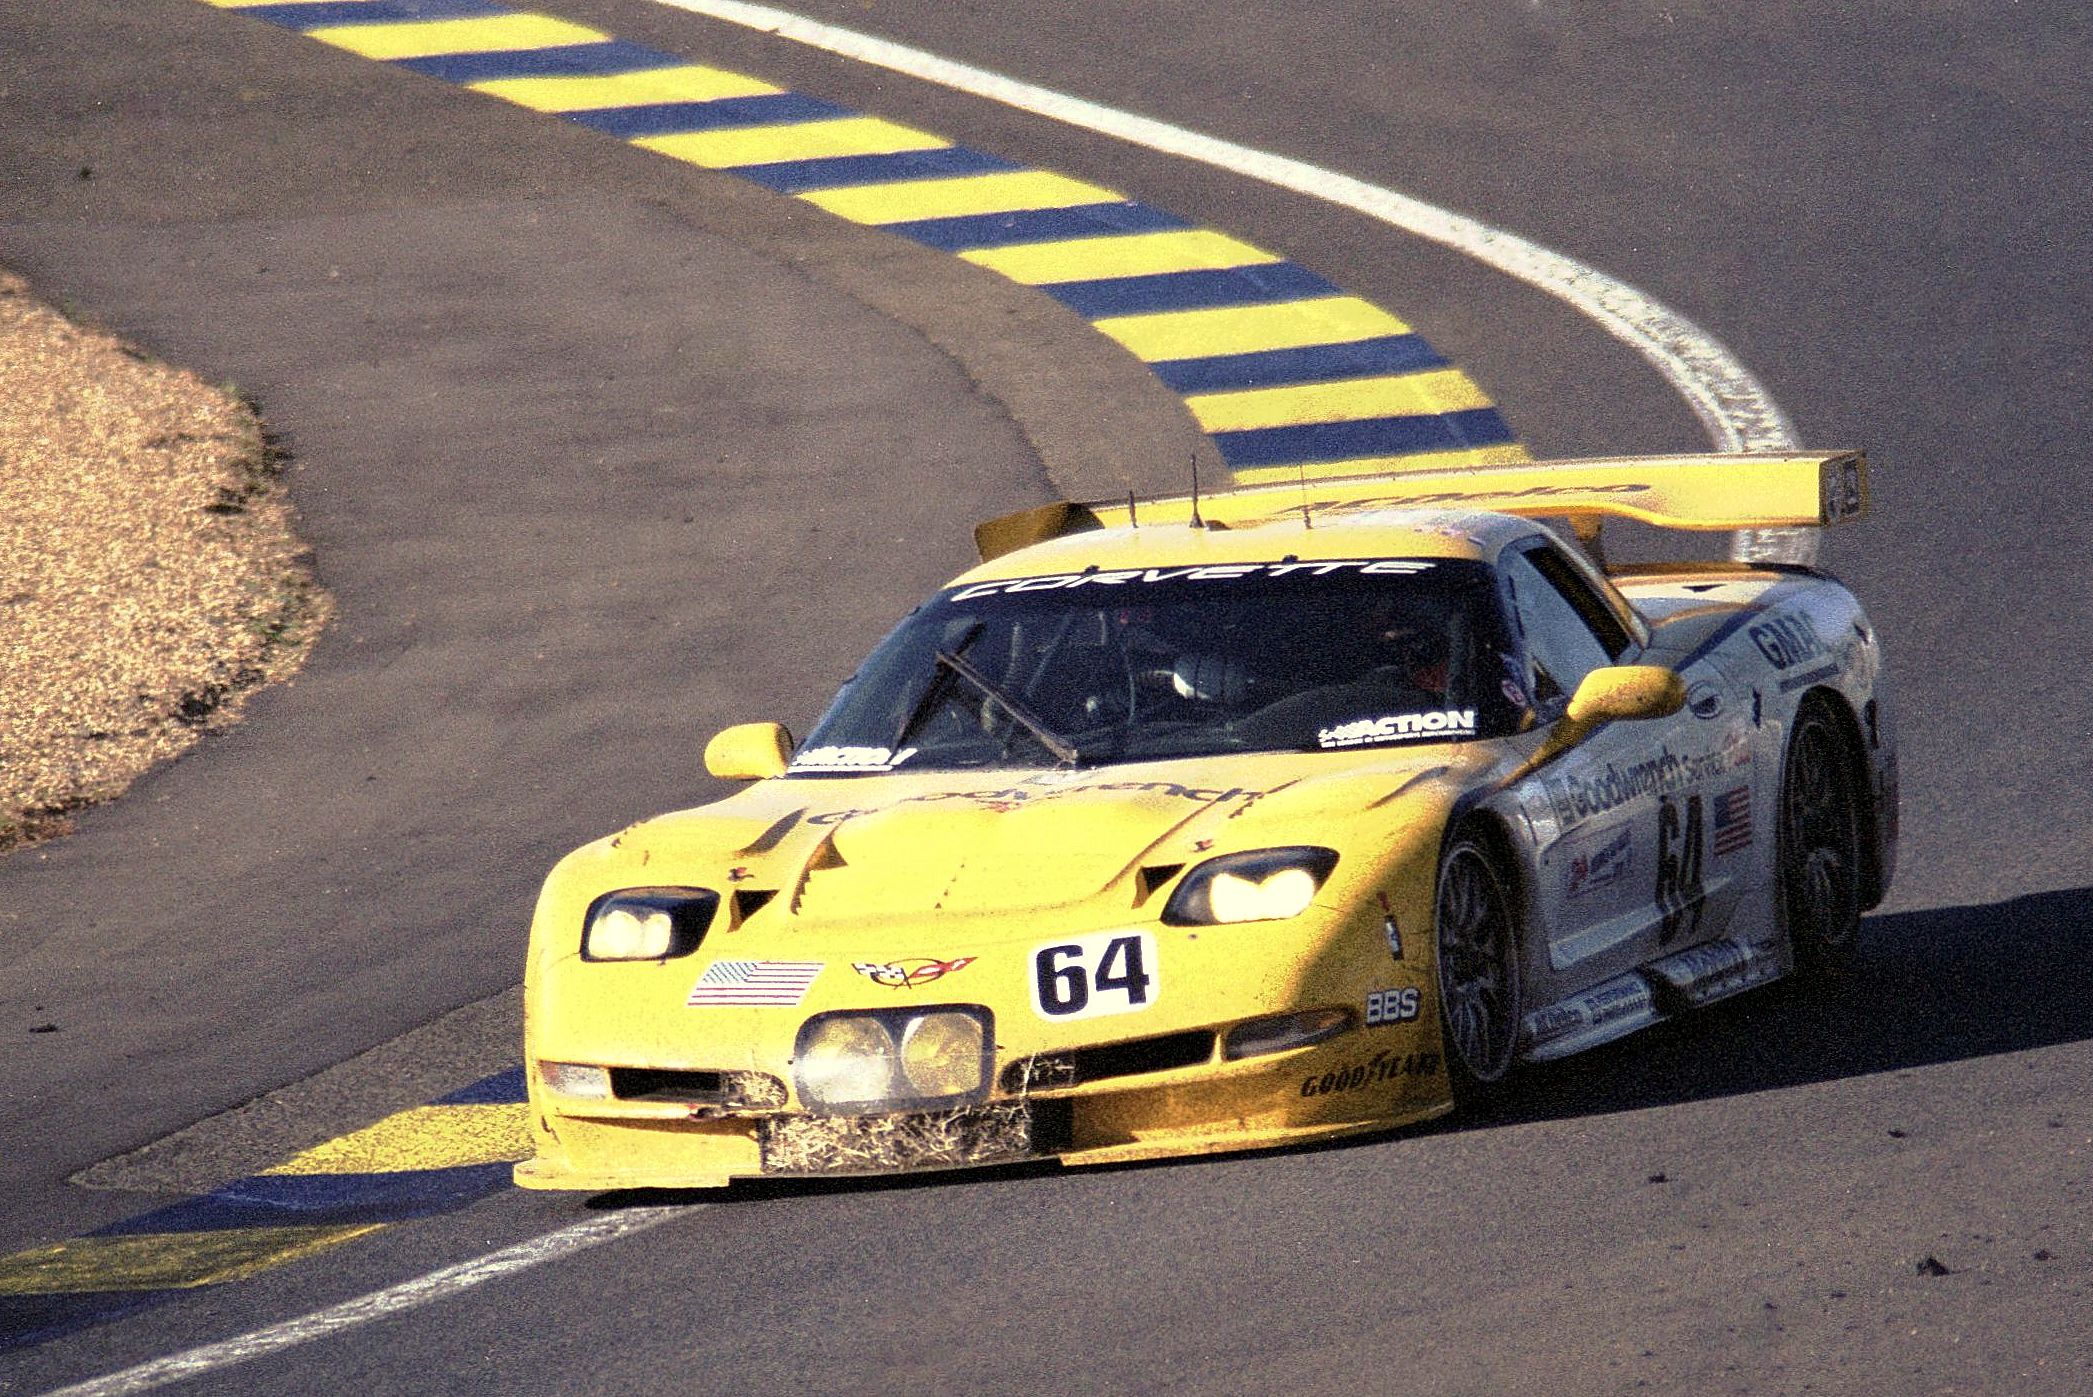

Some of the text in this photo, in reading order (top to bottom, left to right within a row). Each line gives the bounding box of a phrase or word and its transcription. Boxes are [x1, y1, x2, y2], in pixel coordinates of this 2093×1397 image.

[950, 561, 1436, 602] CORVETTE
[1036, 934, 1150, 1016] 64
[1366, 987, 1420, 1025] BBS
